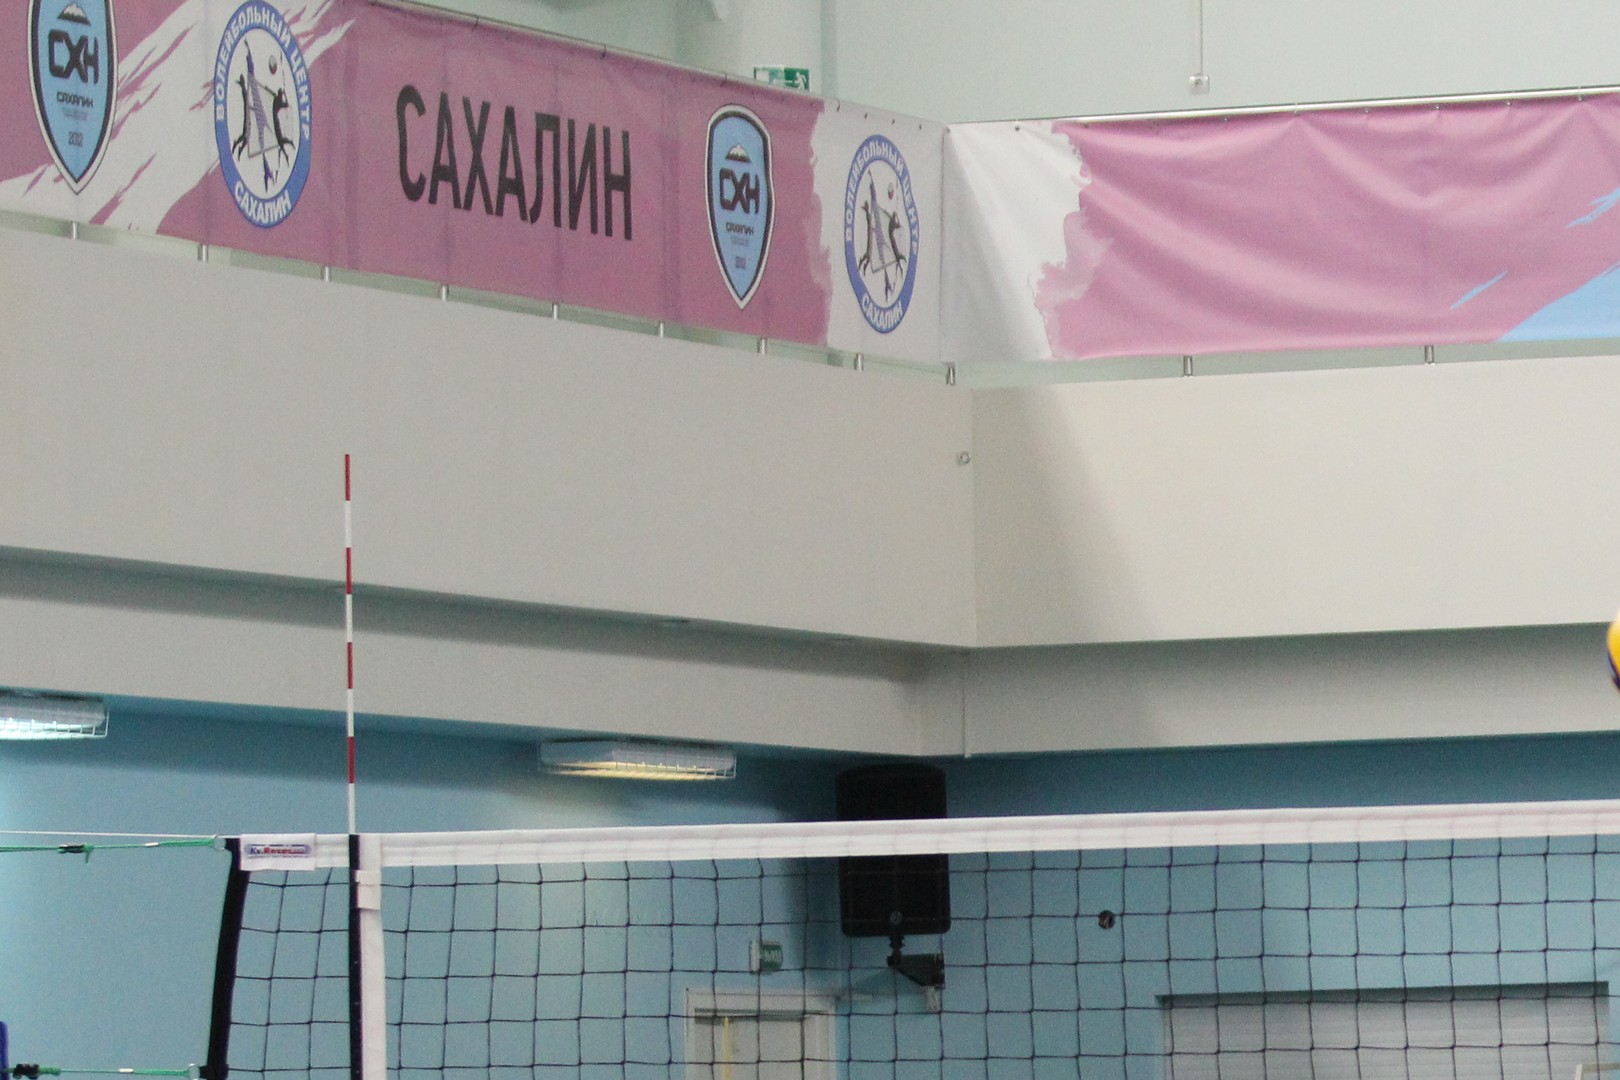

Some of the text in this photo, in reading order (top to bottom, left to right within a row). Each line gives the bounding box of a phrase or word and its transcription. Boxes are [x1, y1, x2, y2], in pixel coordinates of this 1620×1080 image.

[215, 6, 310, 141] ВОЛЕЙБОЛЬНЫЙ ЦЕНТР
[234, 179, 292, 224] САХАЛИН
[396, 84, 632, 241] САХАЛИН
[861, 294, 903, 329] САХАЛИН
